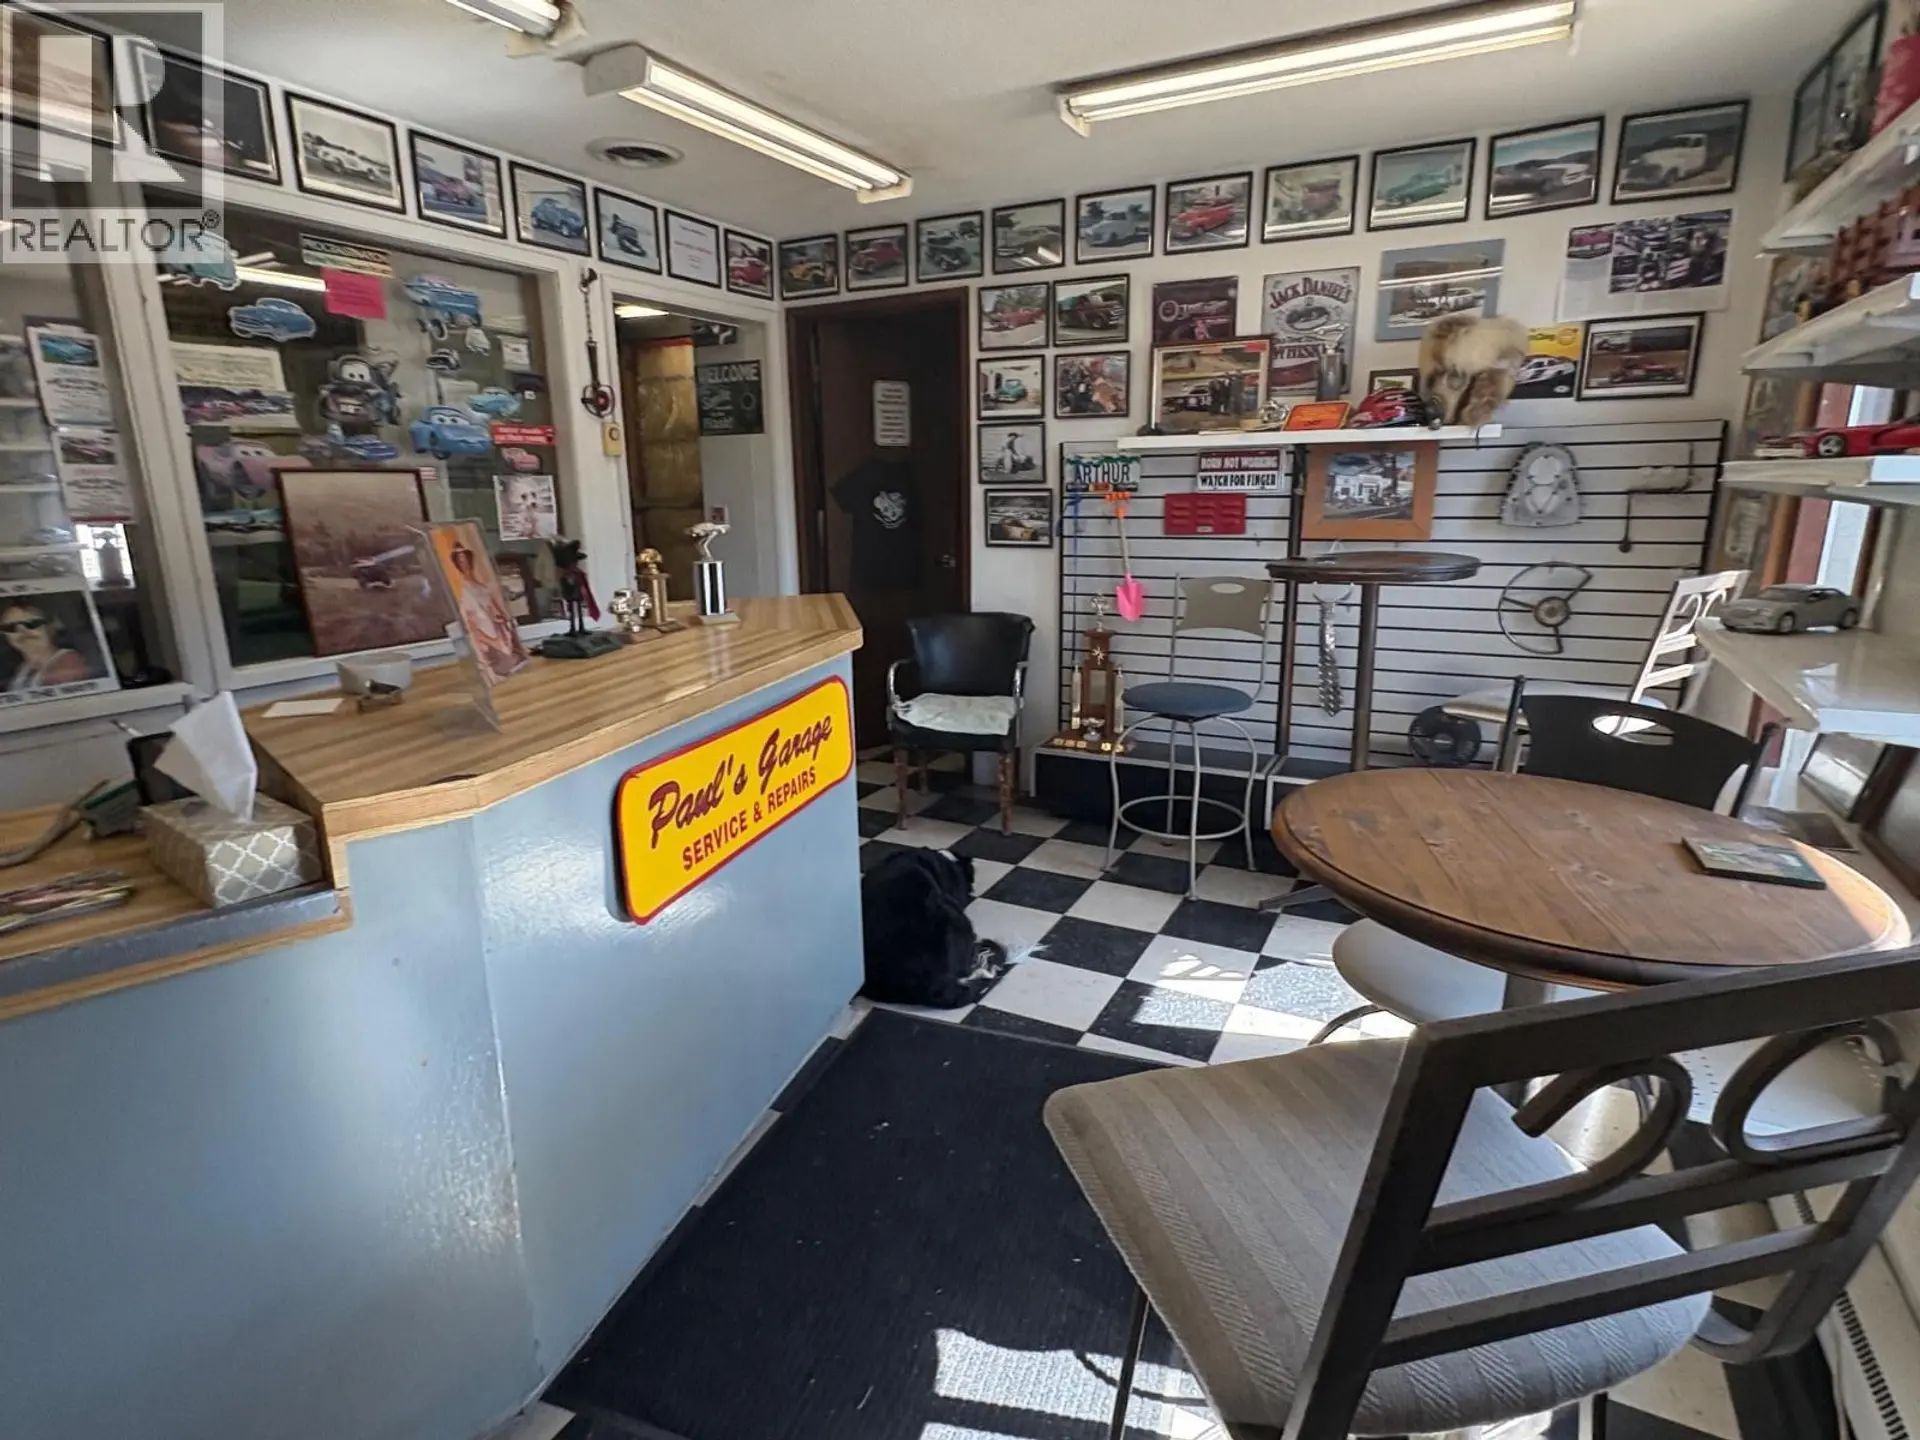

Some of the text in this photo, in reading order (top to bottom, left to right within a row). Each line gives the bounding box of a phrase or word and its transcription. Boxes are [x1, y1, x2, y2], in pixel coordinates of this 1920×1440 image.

[1269, 283, 1301, 309] JACK
[1074, 462, 1131, 484] ARTHUR
[1200, 472, 1276, 487] WATCH FOR FINGER
[648, 715, 832, 849] Paul's Garage
[682, 766, 817, 872] SERVICE & REPAIRS
